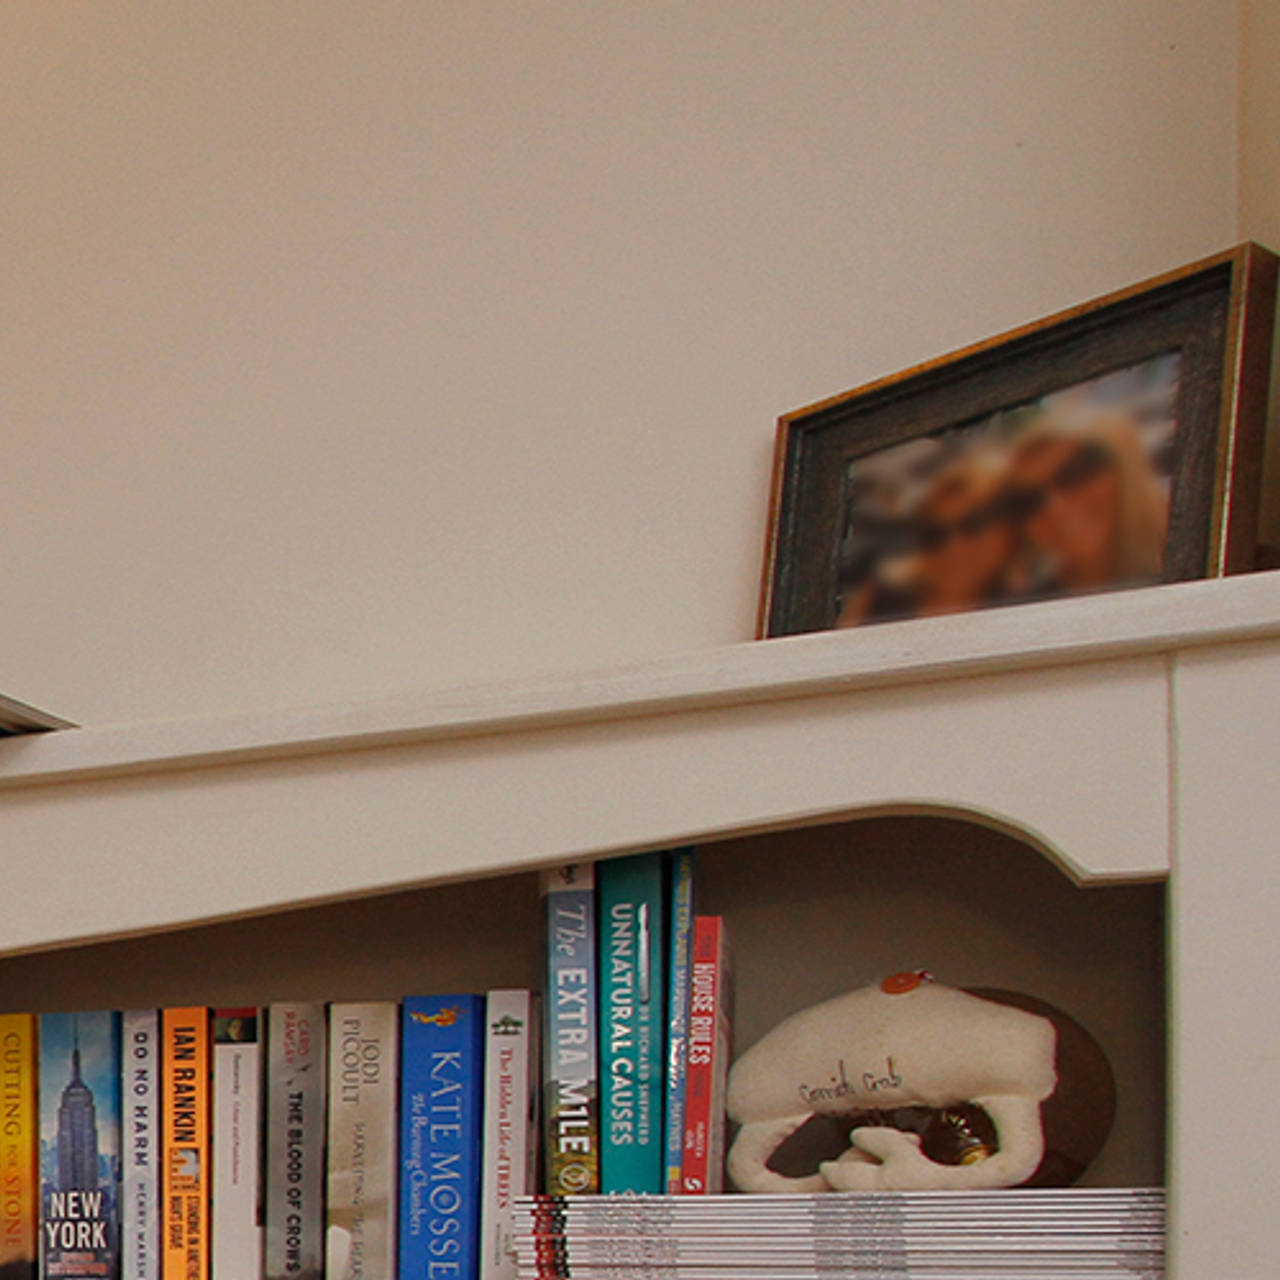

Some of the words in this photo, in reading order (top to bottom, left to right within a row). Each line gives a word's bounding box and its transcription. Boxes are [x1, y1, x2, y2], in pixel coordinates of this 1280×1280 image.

[555, 904, 589, 958] The
[610, 903, 633, 1053] UNNATURAL
[692, 963, 716, 1011] HOUSE
[174, 1026, 195, 1061] IAN
[558, 968, 588, 1067] EXTRA
[689, 1016, 713, 1064] RULES
[134, 1032, 148, 1059] DO
[342, 1020, 359, 1105] PICOULT
[359, 1040, 381, 1086] JODI
[3, 1032, 21, 1136] CUTTING
[134, 1069, 149, 1097] NO
[174, 1068, 197, 1143] RANKIN
[288, 1092, 303, 1126] THE
[430, 1051, 461, 1145] KATE
[610, 1057, 632, 1145] CAUSES
[135, 1105, 148, 1167] HARM
[287, 1129, 302, 1184] BLOOD
[4, 1175, 21, 1249] STONE
[50, 1191, 102, 1219] NEW
[287, 1188, 301, 1210] OF
[46, 1221, 107, 1249] YORK
[285, 1215, 301, 1273] CROWS
